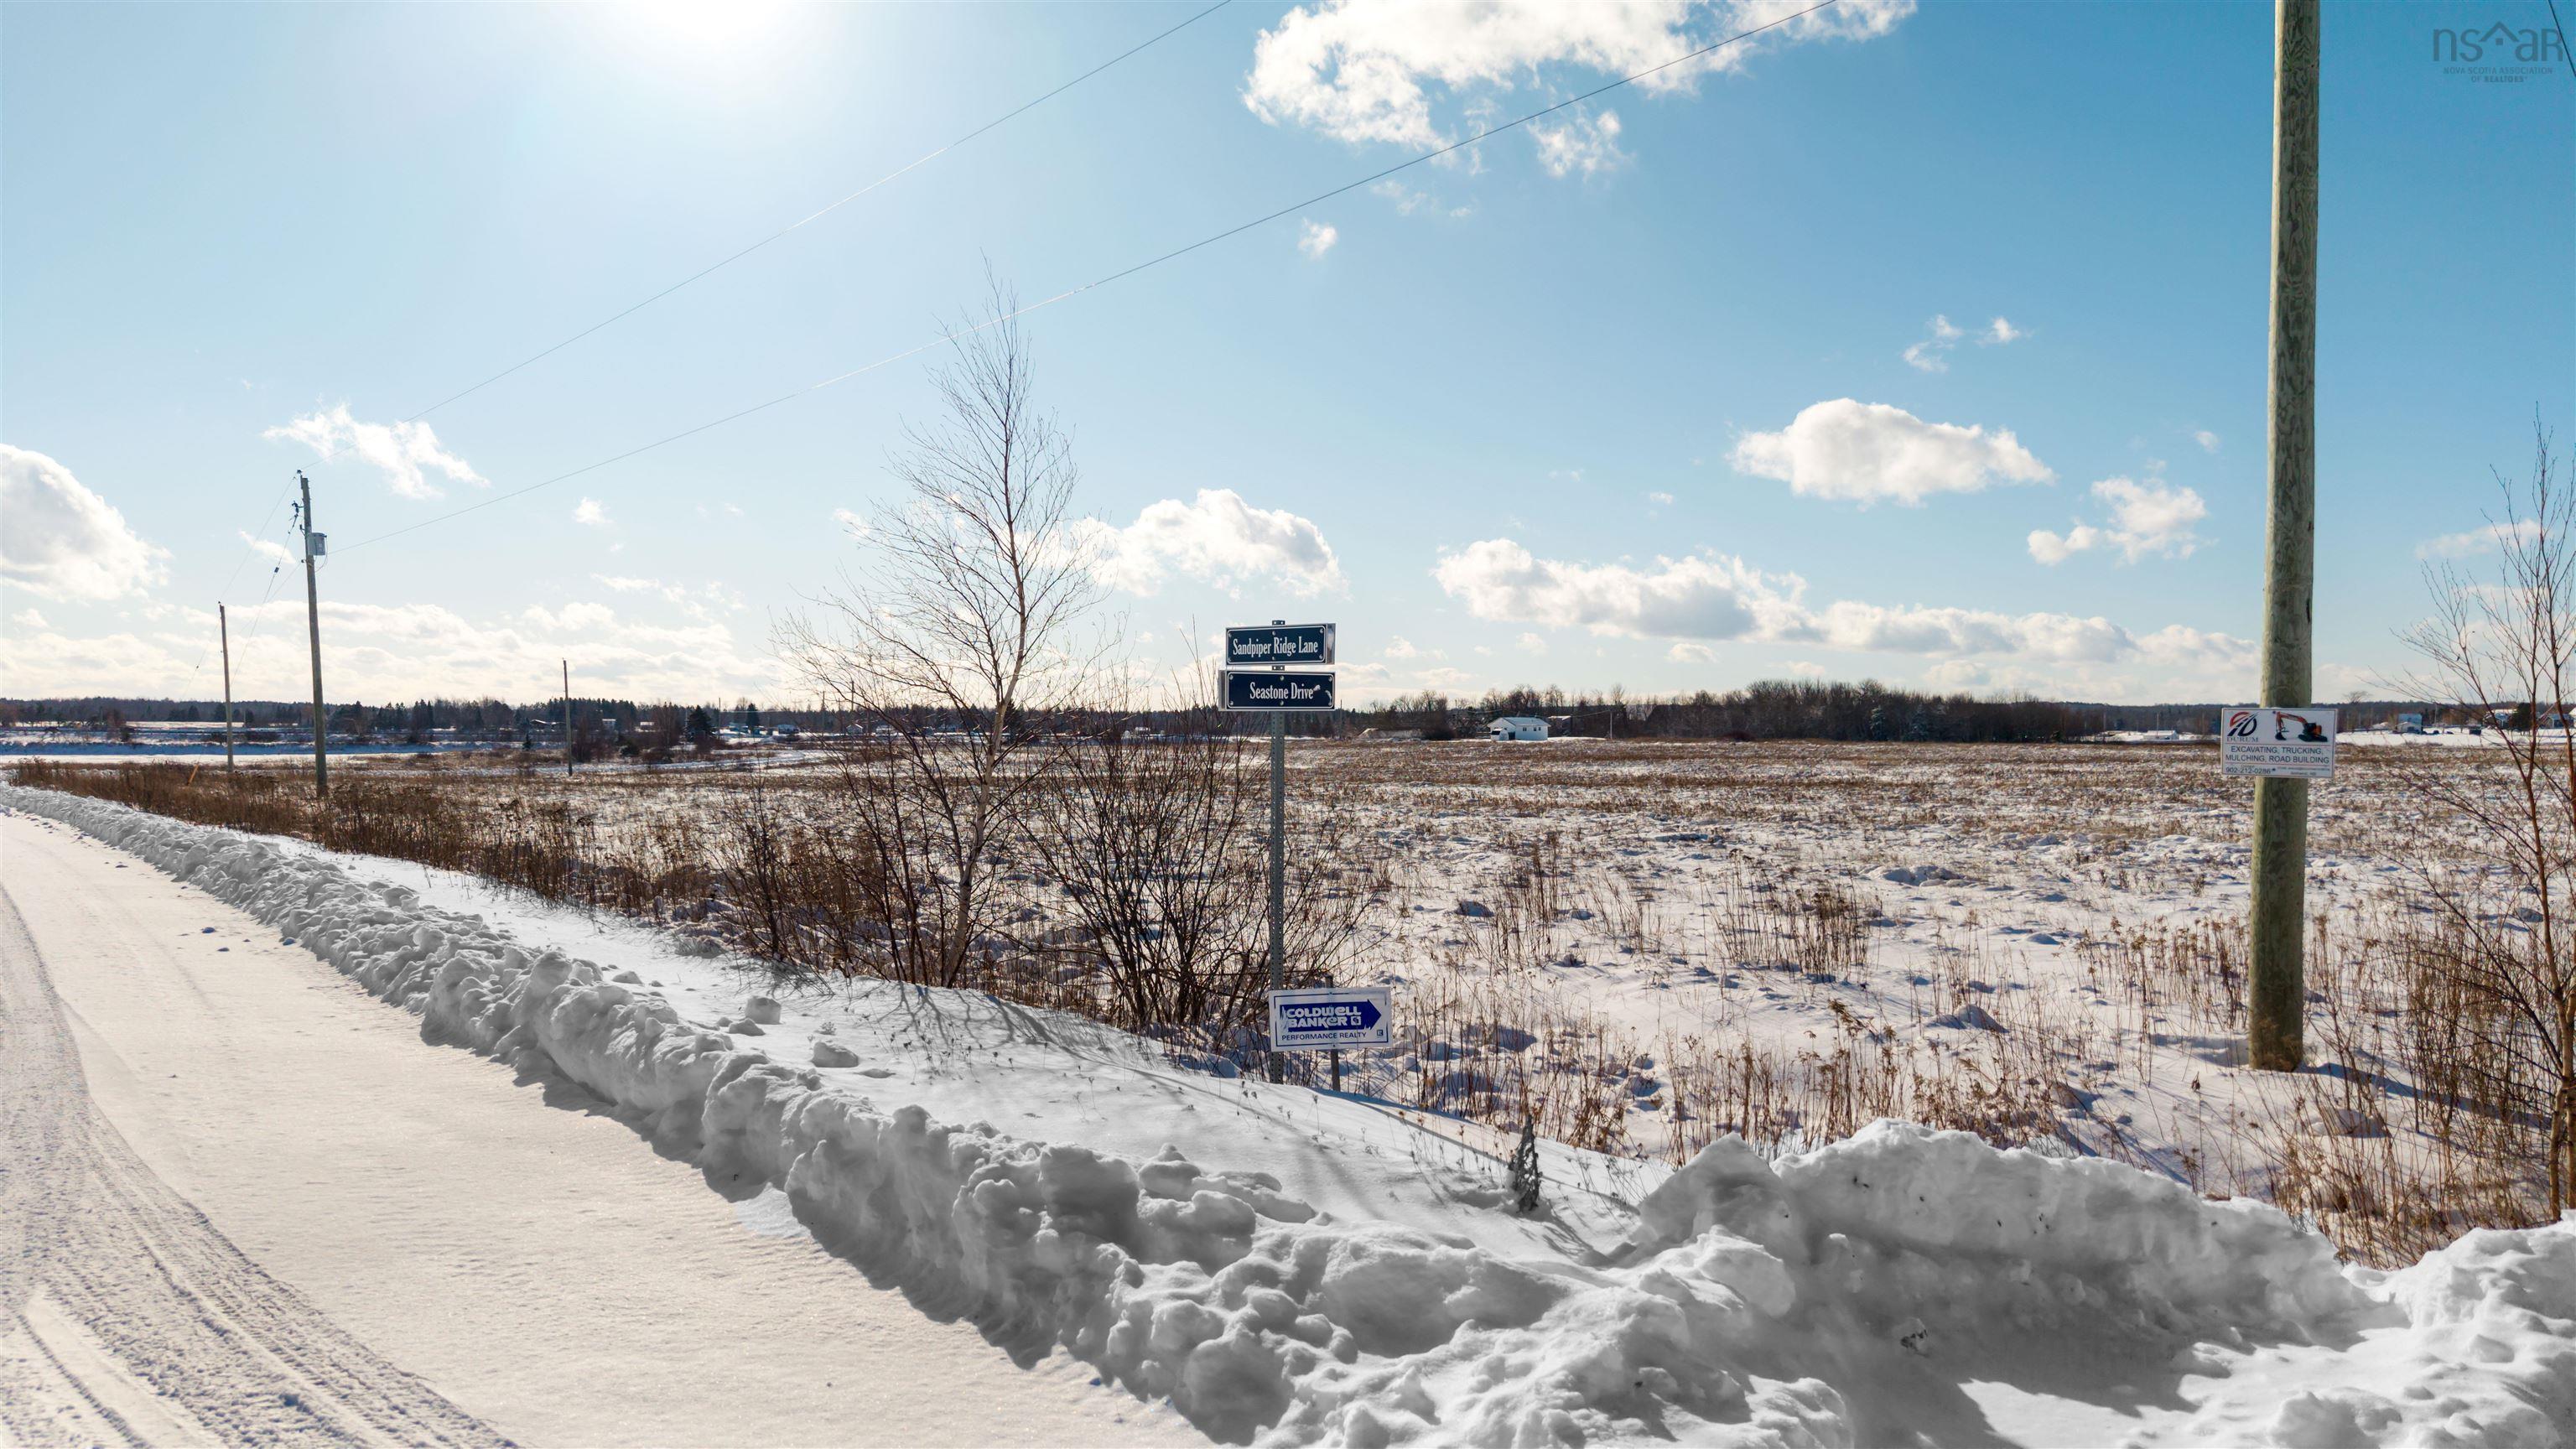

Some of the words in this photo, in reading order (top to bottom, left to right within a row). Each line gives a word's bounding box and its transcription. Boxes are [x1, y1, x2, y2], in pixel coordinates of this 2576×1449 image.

[1233, 638, 1271, 657] Sandpiper
[1273, 636, 1296, 657] Ridge
[1298, 636, 1318, 653] Lane
[1249, 682, 1289, 699] Seastone
[1291, 682, 1313, 699] Drive
[2231, 745, 2279, 755] EXCAVATING,
[2268, 755, 2291, 763] ROAD
[2293, 756, 2329, 764] BUILDING
[1281, 1032, 1337, 1041] PERFORMANCE
